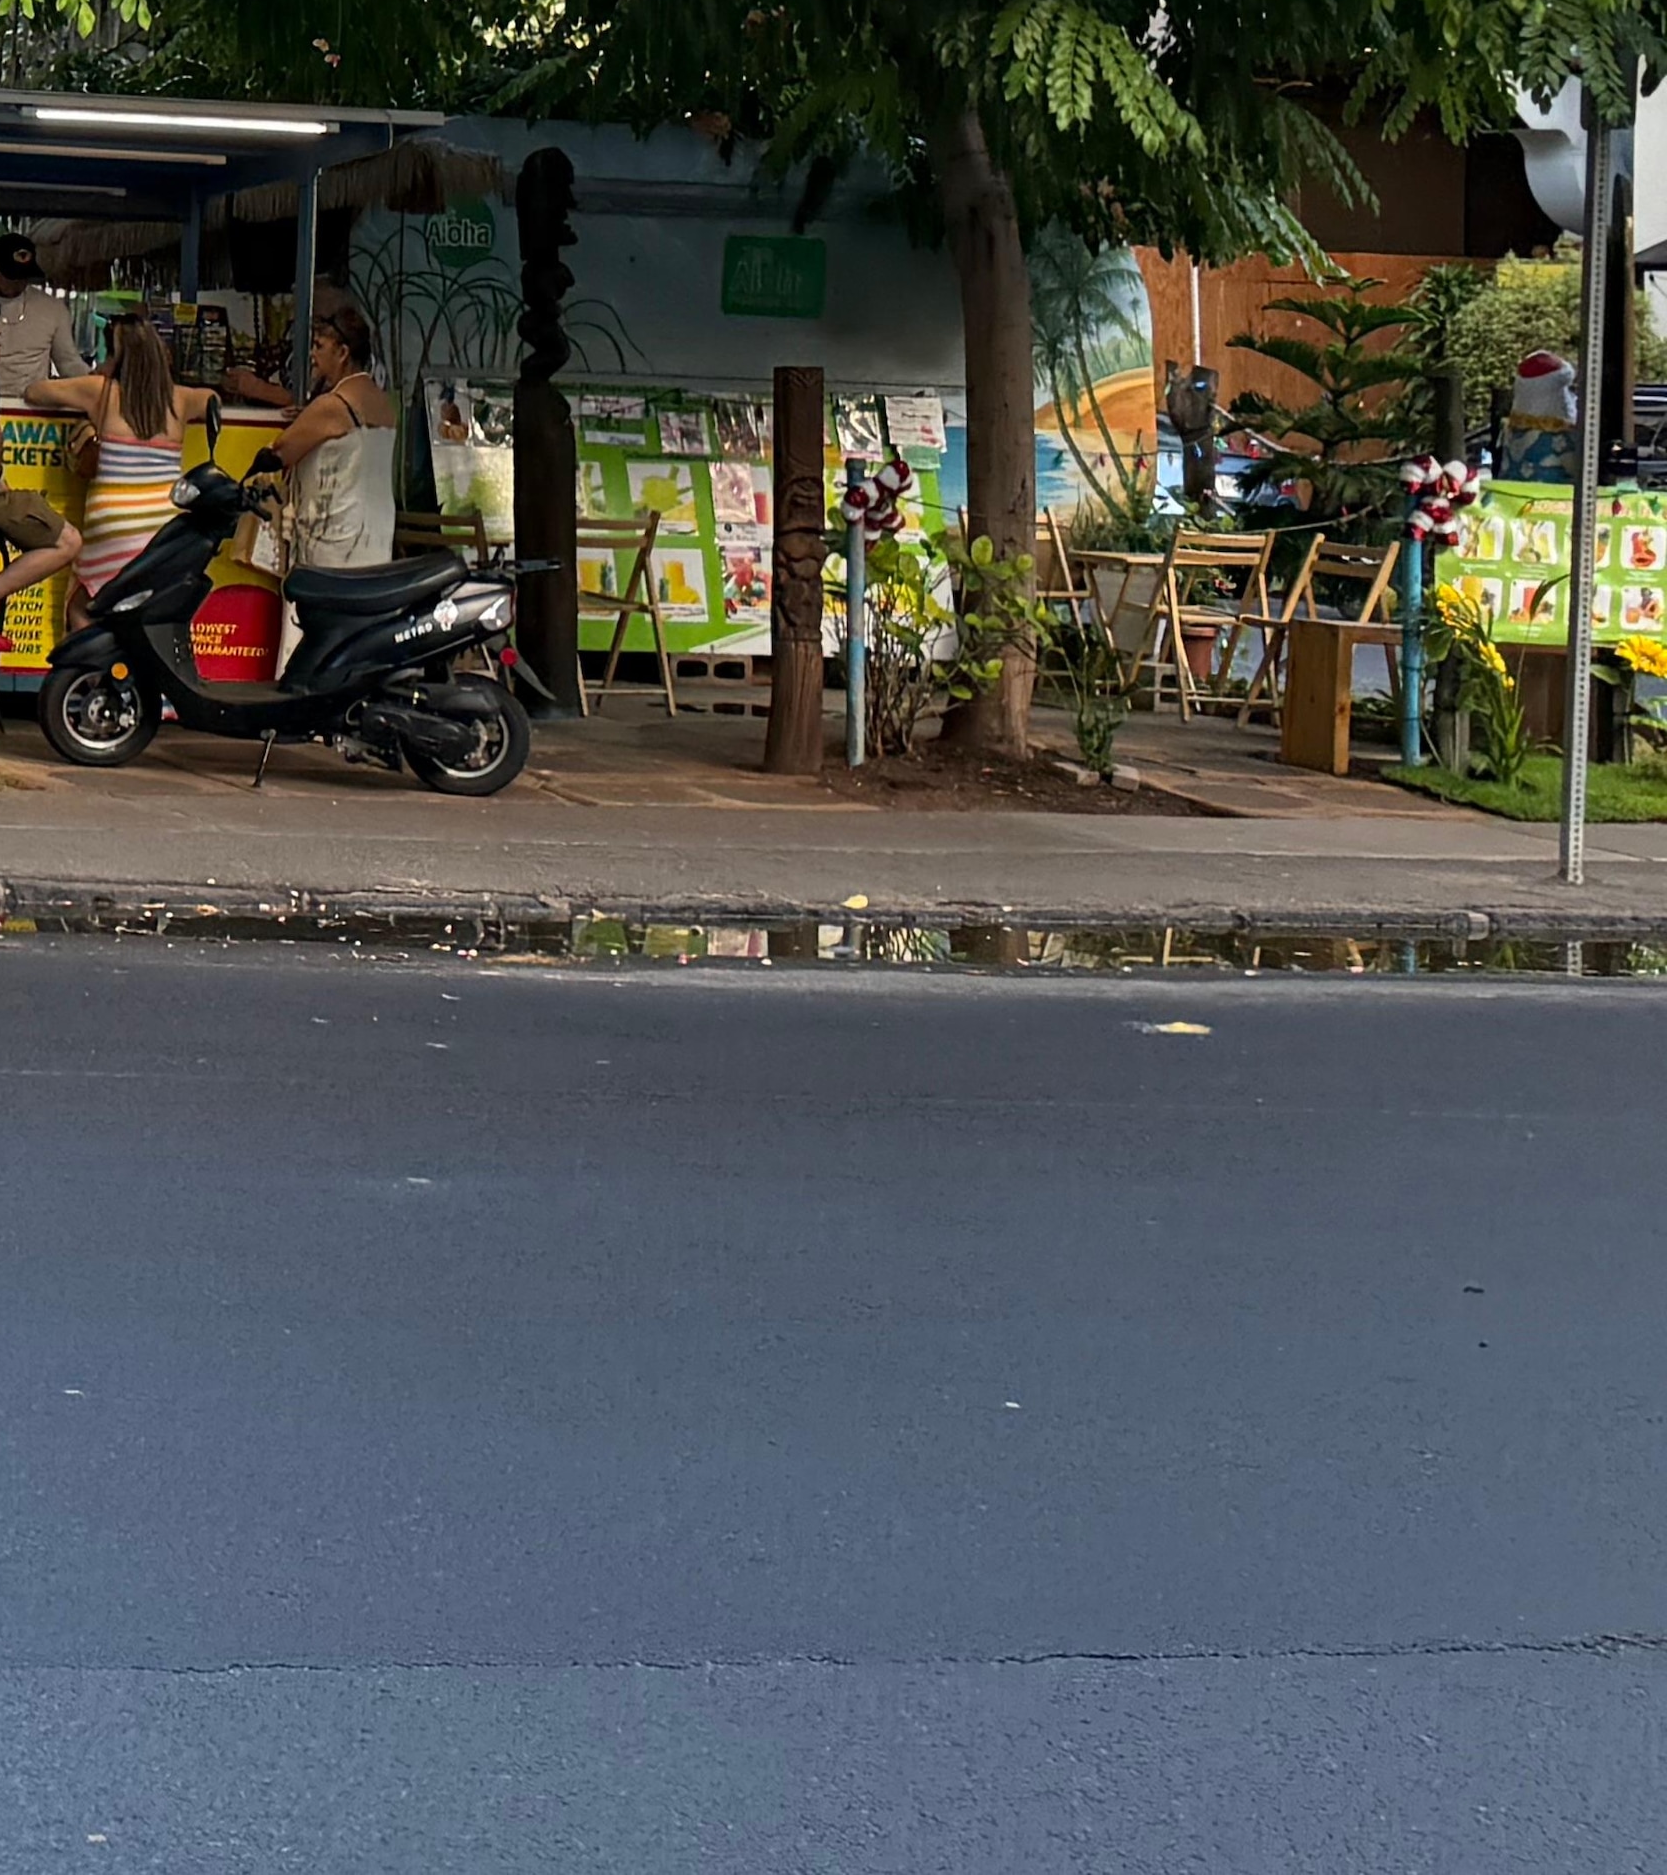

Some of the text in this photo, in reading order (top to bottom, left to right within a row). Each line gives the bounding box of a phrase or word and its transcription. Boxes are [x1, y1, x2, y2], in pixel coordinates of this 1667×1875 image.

[425, 216, 494, 248] Aloha
[2, 420, 75, 446] AWAI
[1, 447, 62, 467] CKETS
[5, 629, 43, 641] RUISE
[394, 621, 433, 644] METRO
